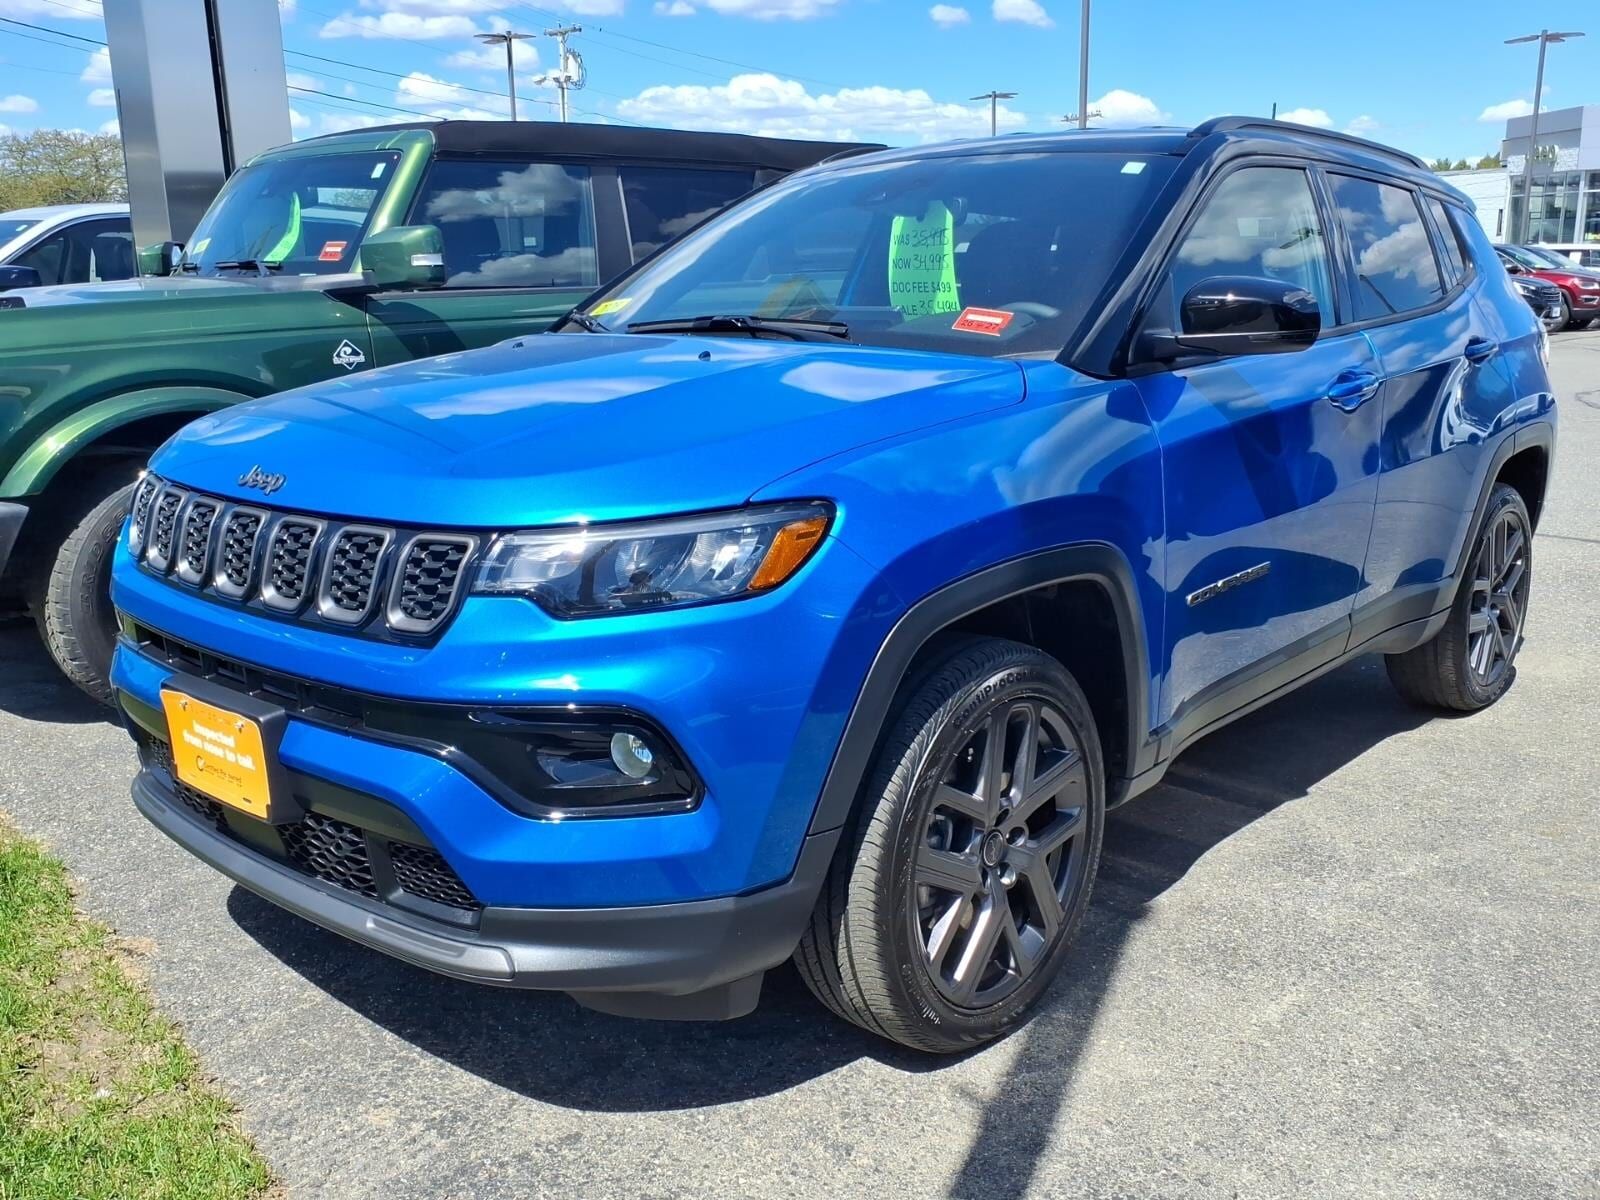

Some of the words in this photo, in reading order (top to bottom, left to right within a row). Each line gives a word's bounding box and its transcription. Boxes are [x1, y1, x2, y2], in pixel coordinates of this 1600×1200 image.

[894, 234, 910, 246] WAS
[893, 257, 911, 269] NOW
[912, 253, 950, 272] 34,995
[892, 281, 911, 293] DOC
[912, 281, 929, 293] FEE
[931, 281, 951, 293] $499
[895, 304, 918, 316] ALE
[238, 464, 286, 496] Jeep
